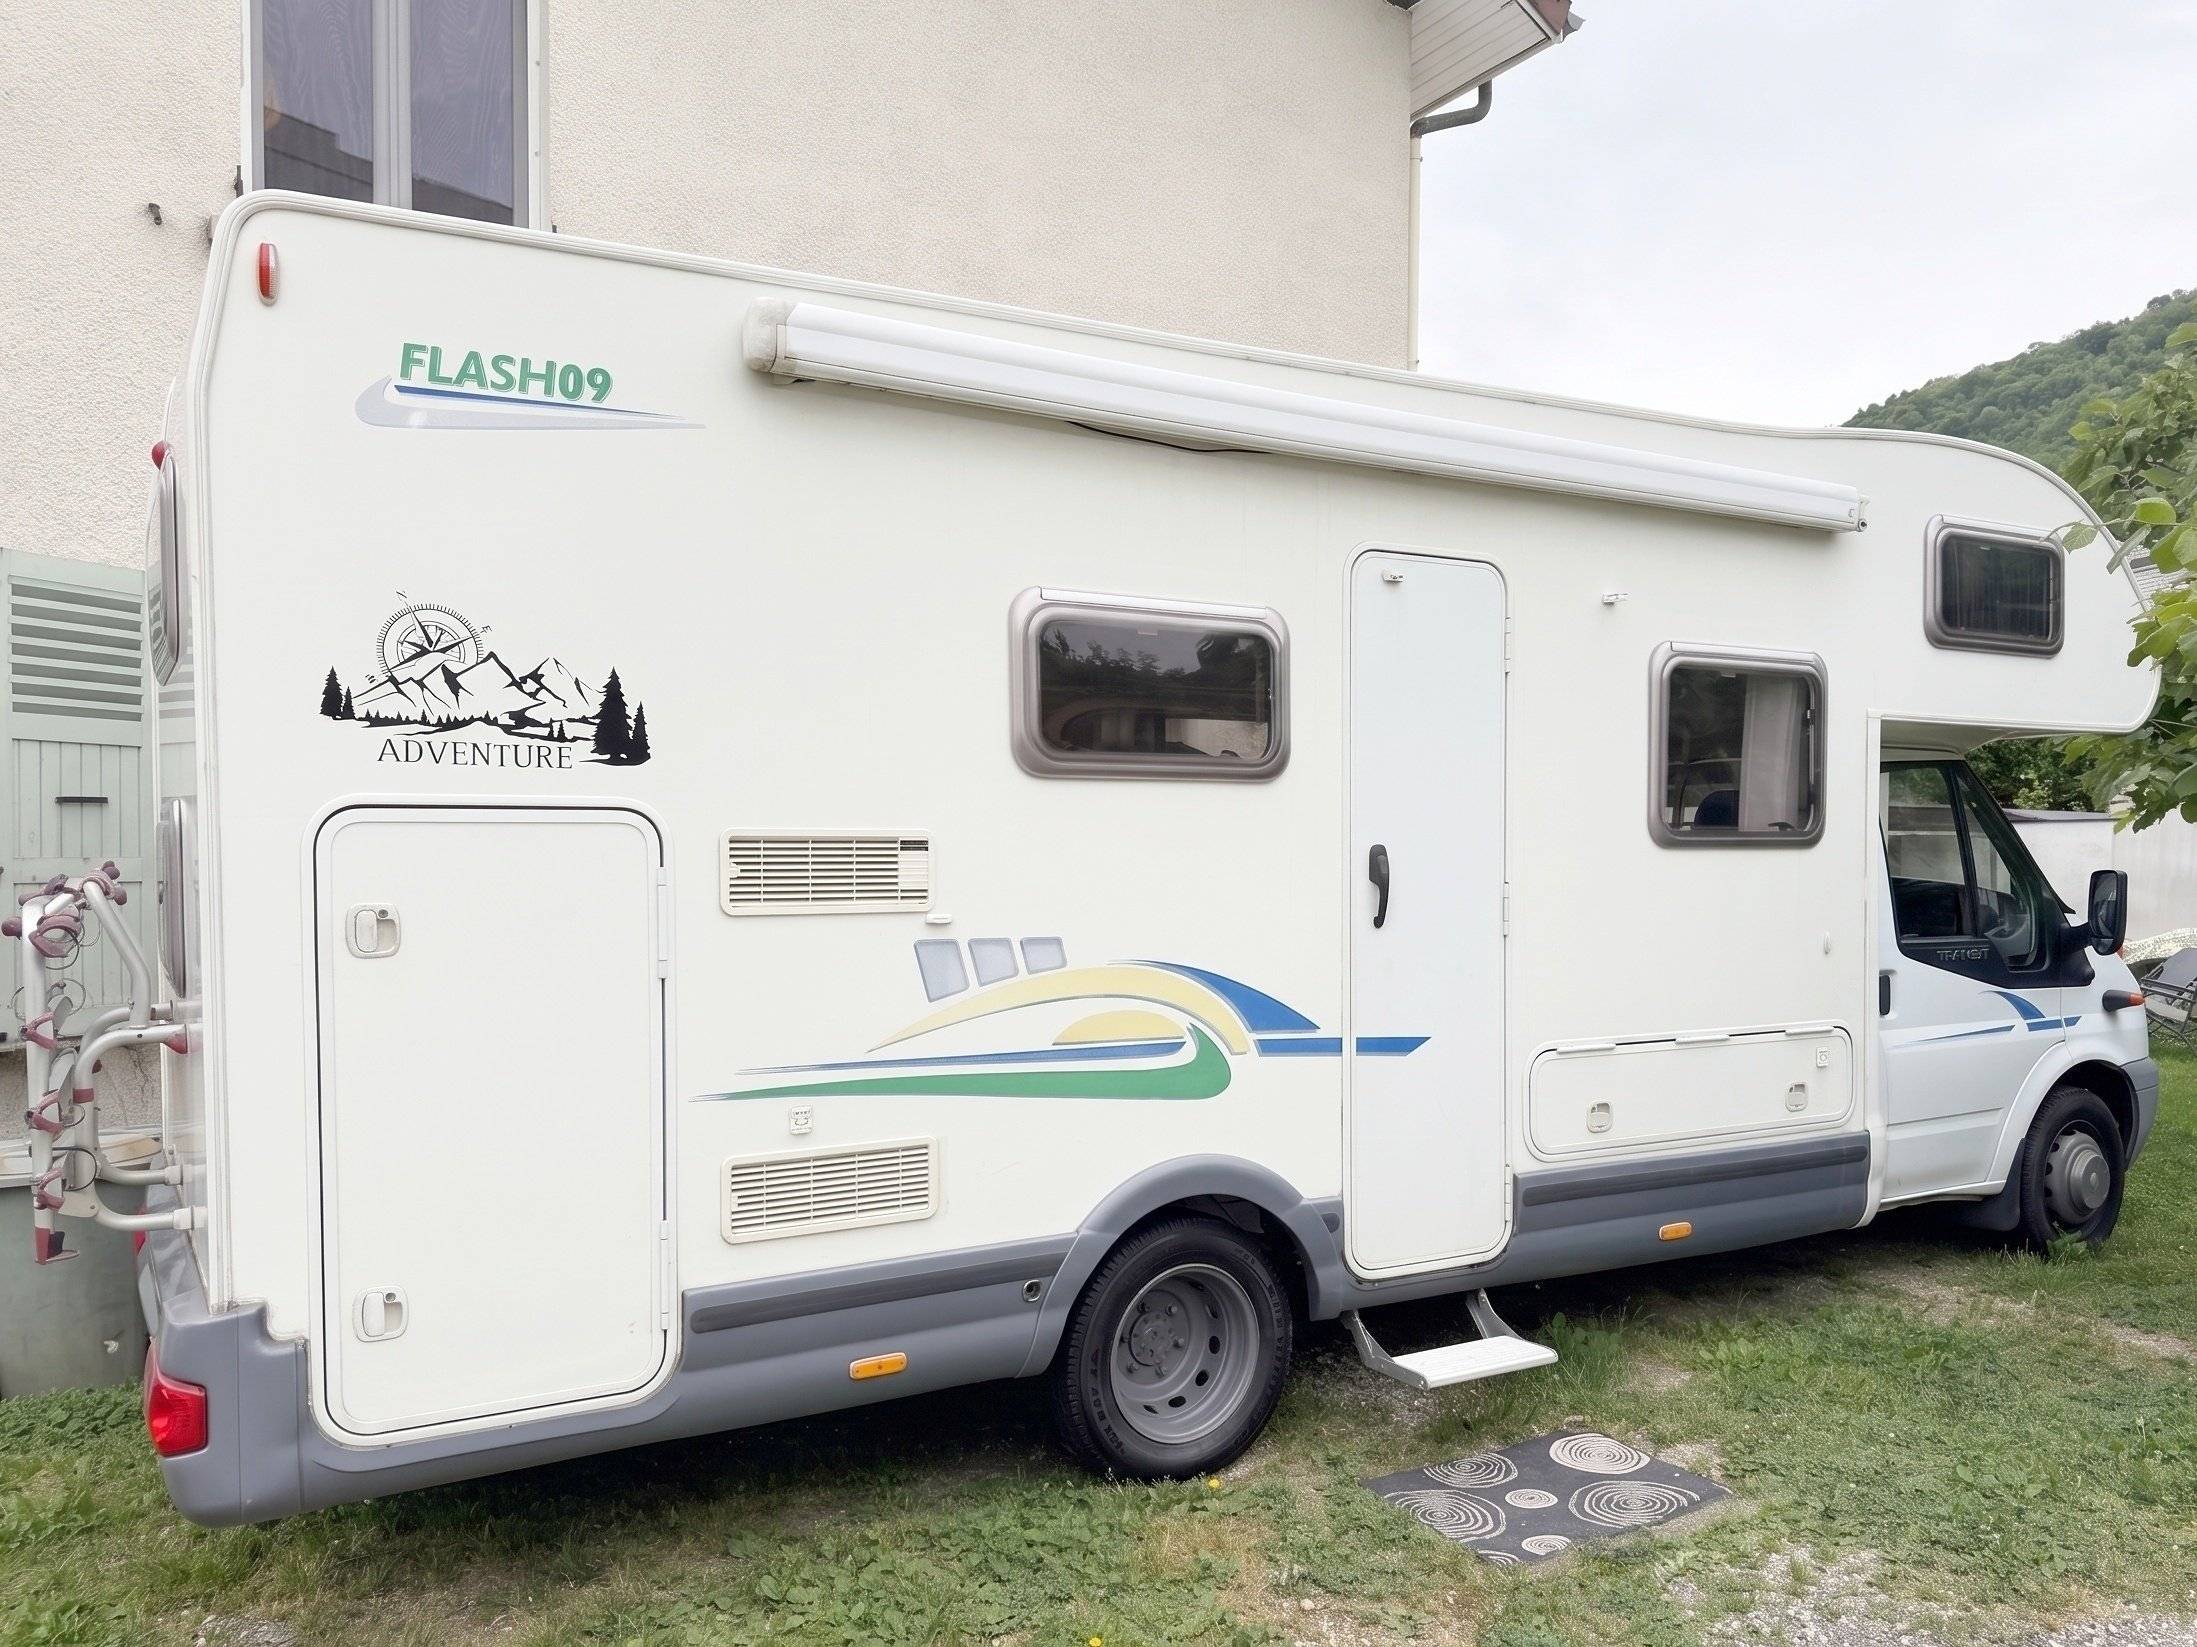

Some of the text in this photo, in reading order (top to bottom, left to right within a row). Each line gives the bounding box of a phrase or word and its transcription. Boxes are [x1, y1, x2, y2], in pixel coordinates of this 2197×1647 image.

[400, 342, 613, 402] FLASH09
[376, 738, 573, 769] ADVENTURE
[1936, 948, 1990, 961] TRAT
